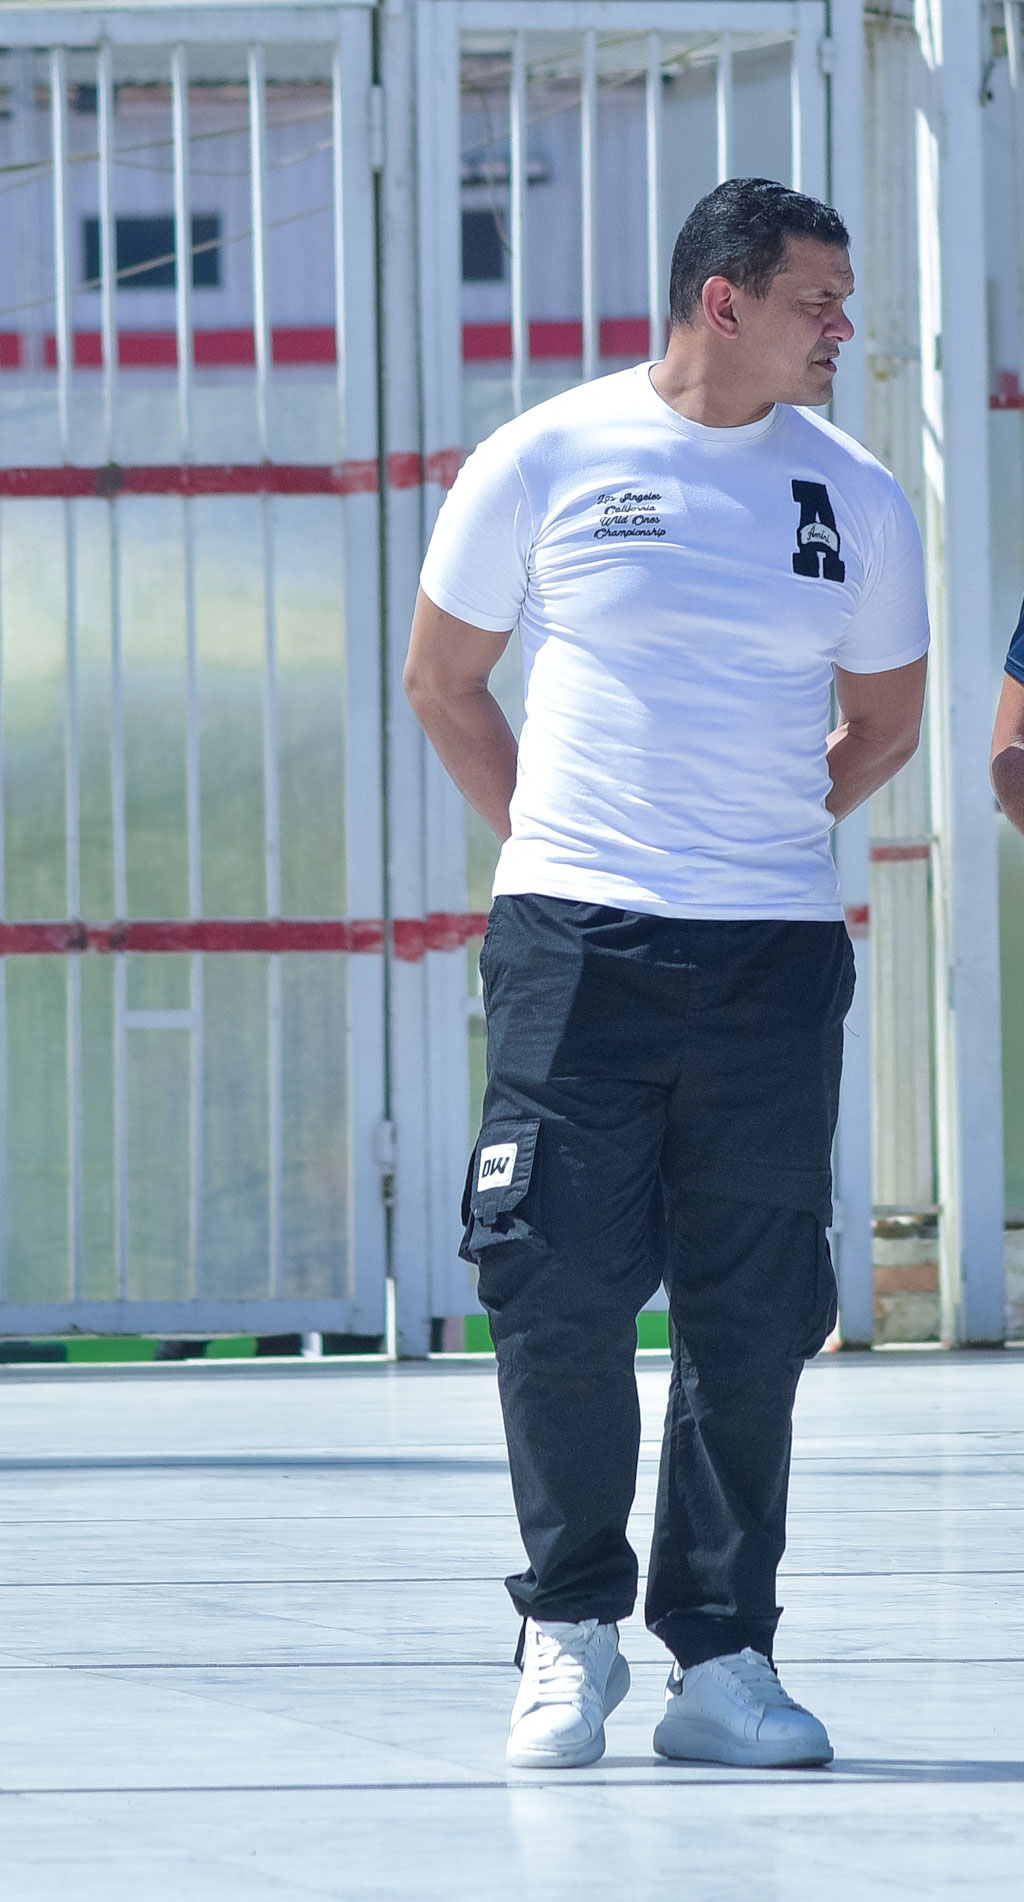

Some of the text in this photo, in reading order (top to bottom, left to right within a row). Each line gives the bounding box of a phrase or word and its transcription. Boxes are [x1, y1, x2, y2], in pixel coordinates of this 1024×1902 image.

[597, 492, 662, 505] Los Angeles
[604, 504, 656, 515] California
[600, 515, 661, 527] Wild Ones
[594, 527, 666, 539] Championship
